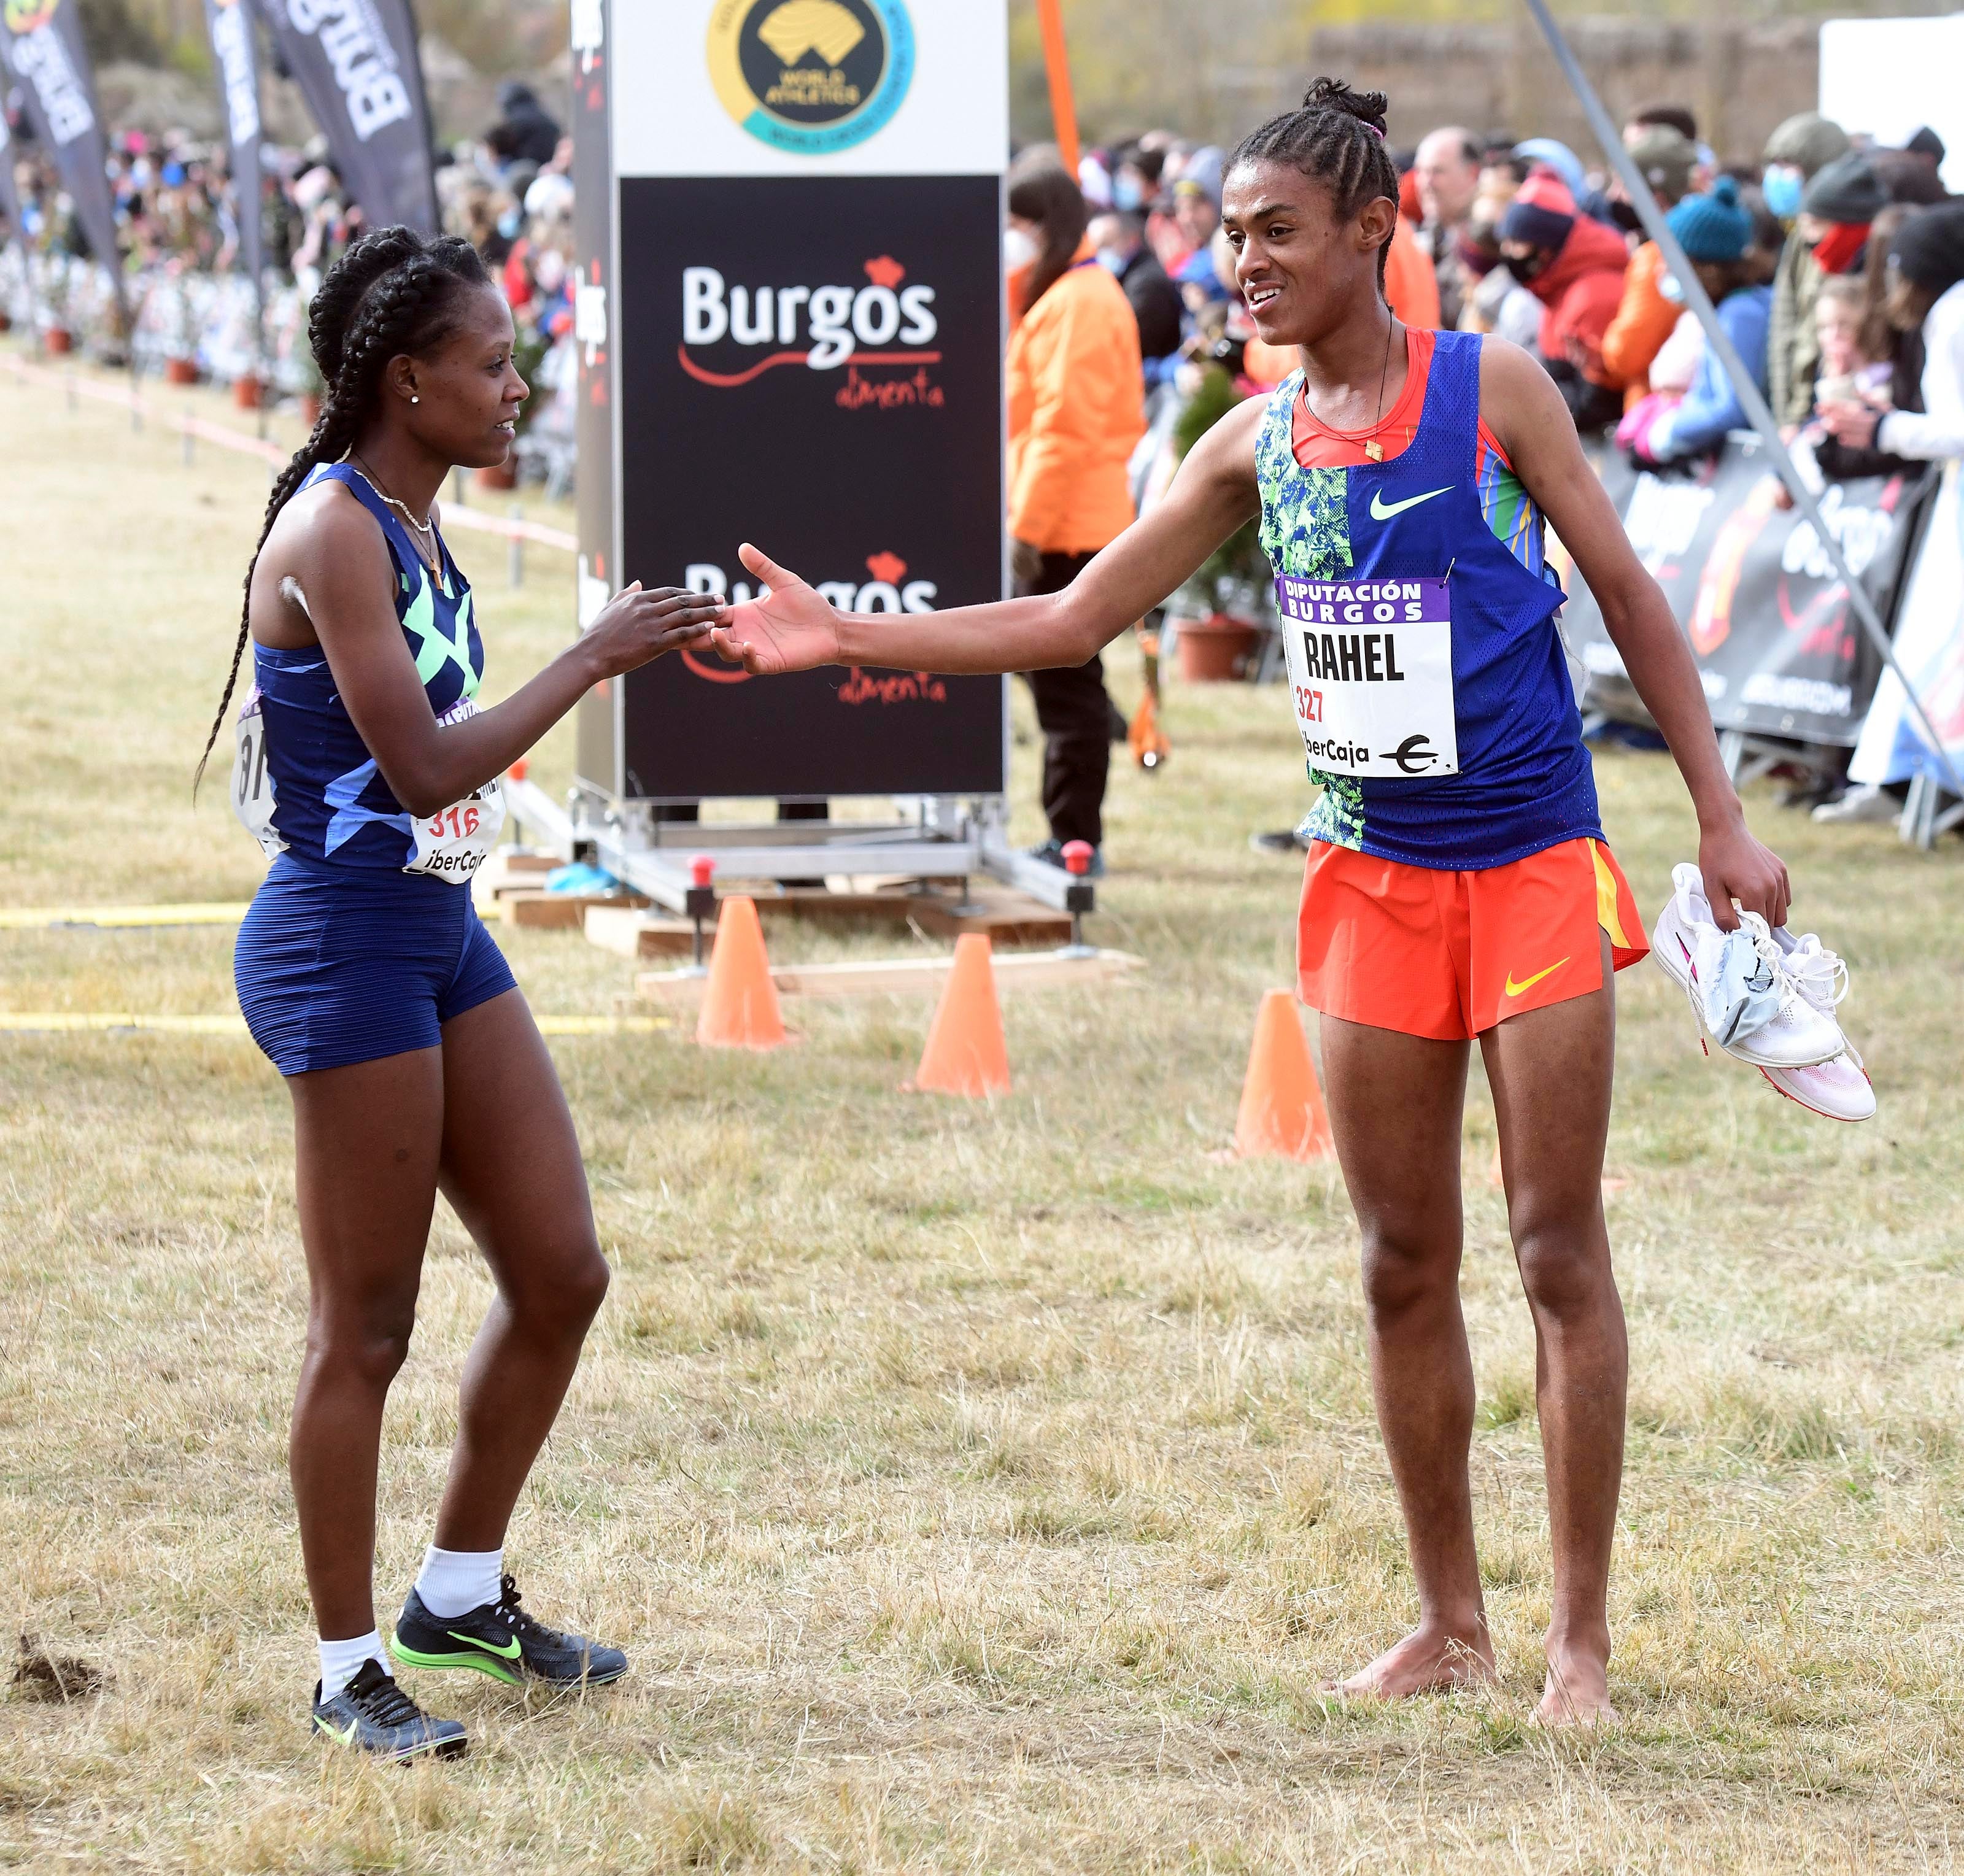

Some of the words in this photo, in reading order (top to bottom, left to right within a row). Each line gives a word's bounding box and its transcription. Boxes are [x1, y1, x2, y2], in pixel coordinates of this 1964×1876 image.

[779, 69, 846, 87] WORLD
[765, 85, 860, 105] ATHLETICS
[681, 266, 938, 370] Burgos
[1285, 580, 1421, 602] DIPUTACIÓN
[1288, 598, 1423, 623] BURGOS
[1304, 631, 1404, 681] RAHEL
[1296, 685, 1323, 722] 327
[428, 806, 479, 838] 316
